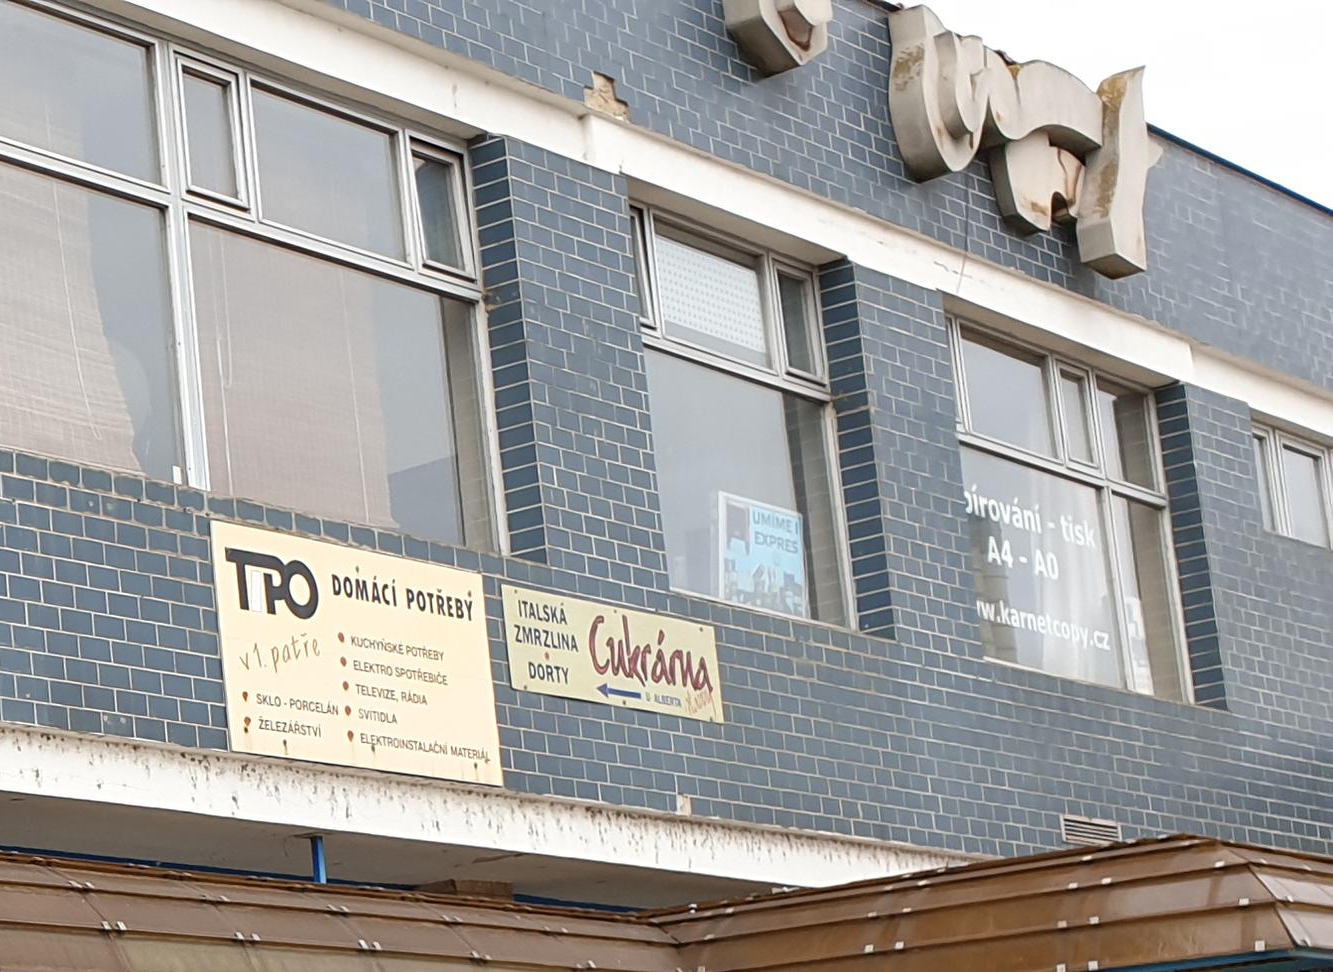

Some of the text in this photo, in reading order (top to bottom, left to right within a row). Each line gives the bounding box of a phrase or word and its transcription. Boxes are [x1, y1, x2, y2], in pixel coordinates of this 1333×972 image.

[754, 531, 798, 553] EXPRES
[1059, 513, 1097, 548] tisk
[987, 536, 1014, 568] A4
[1033, 549, 1059, 580] A0
[225, 547, 319, 620] TPO
[331, 575, 474, 621] DOMÁCÍ POTŘEBY
[518, 600, 568, 626] ITALSKÁ
[350, 635, 445, 662] KUCHYŇSKÉ POTŘEBY
[513, 624, 579, 652] ZMRZLINA
[270, 632, 321, 673] patře
[588, 614, 714, 694] Cukrárna
[352, 660, 448, 686] ELEKTRO SPOTŘEBIČE
[528, 661, 569, 684] DORTY
[256, 693, 281, 708] SKLO
[289, 697, 339, 717] PORCELÁN
[401, 689, 428, 706] RÁDIA
[258, 716, 322, 739] ŽELEZÁŘSTVÍ
[360, 733, 448, 756] ELEKTROINSTALAČNÍ
